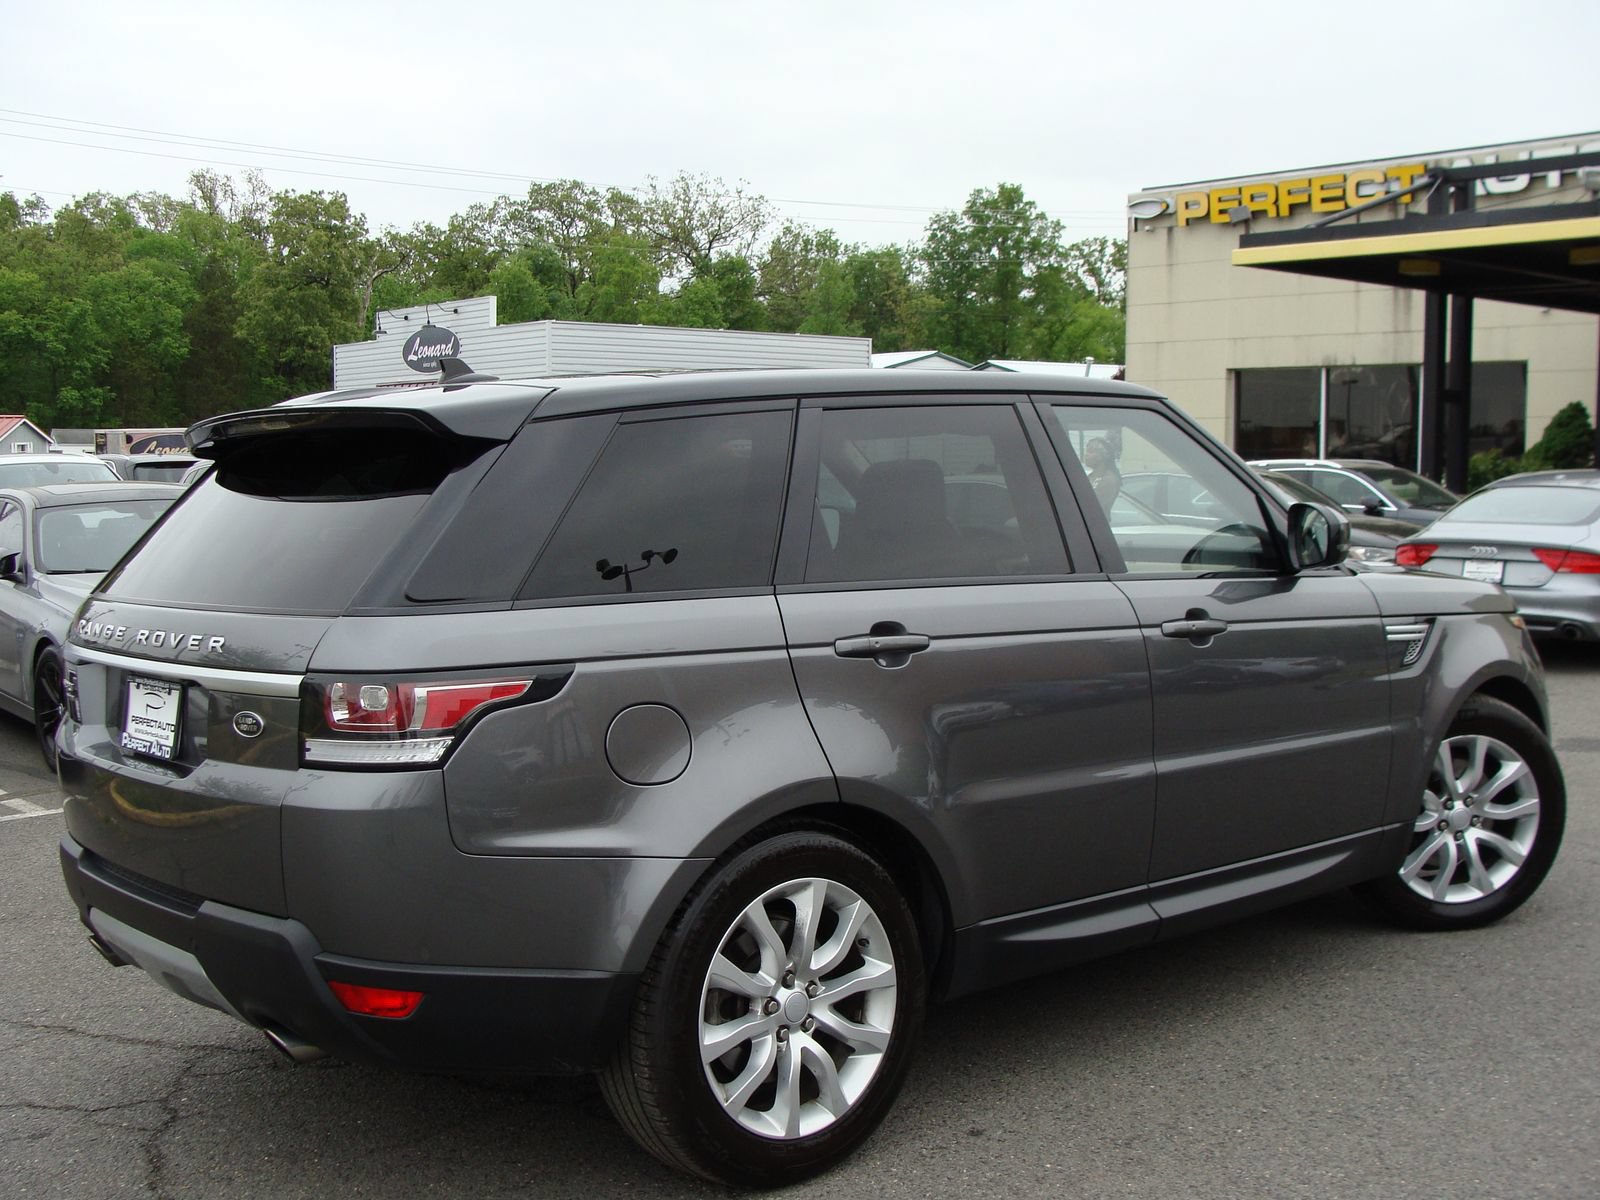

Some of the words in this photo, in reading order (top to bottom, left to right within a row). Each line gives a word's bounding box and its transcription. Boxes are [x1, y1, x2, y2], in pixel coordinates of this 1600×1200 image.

[1176, 164, 1426, 227] PERFECT
[407, 335, 455, 361] Leonard
[143, 440, 190, 455] Leona
[77, 619, 127, 641] RANGE
[136, 629, 225, 653] ROVER
